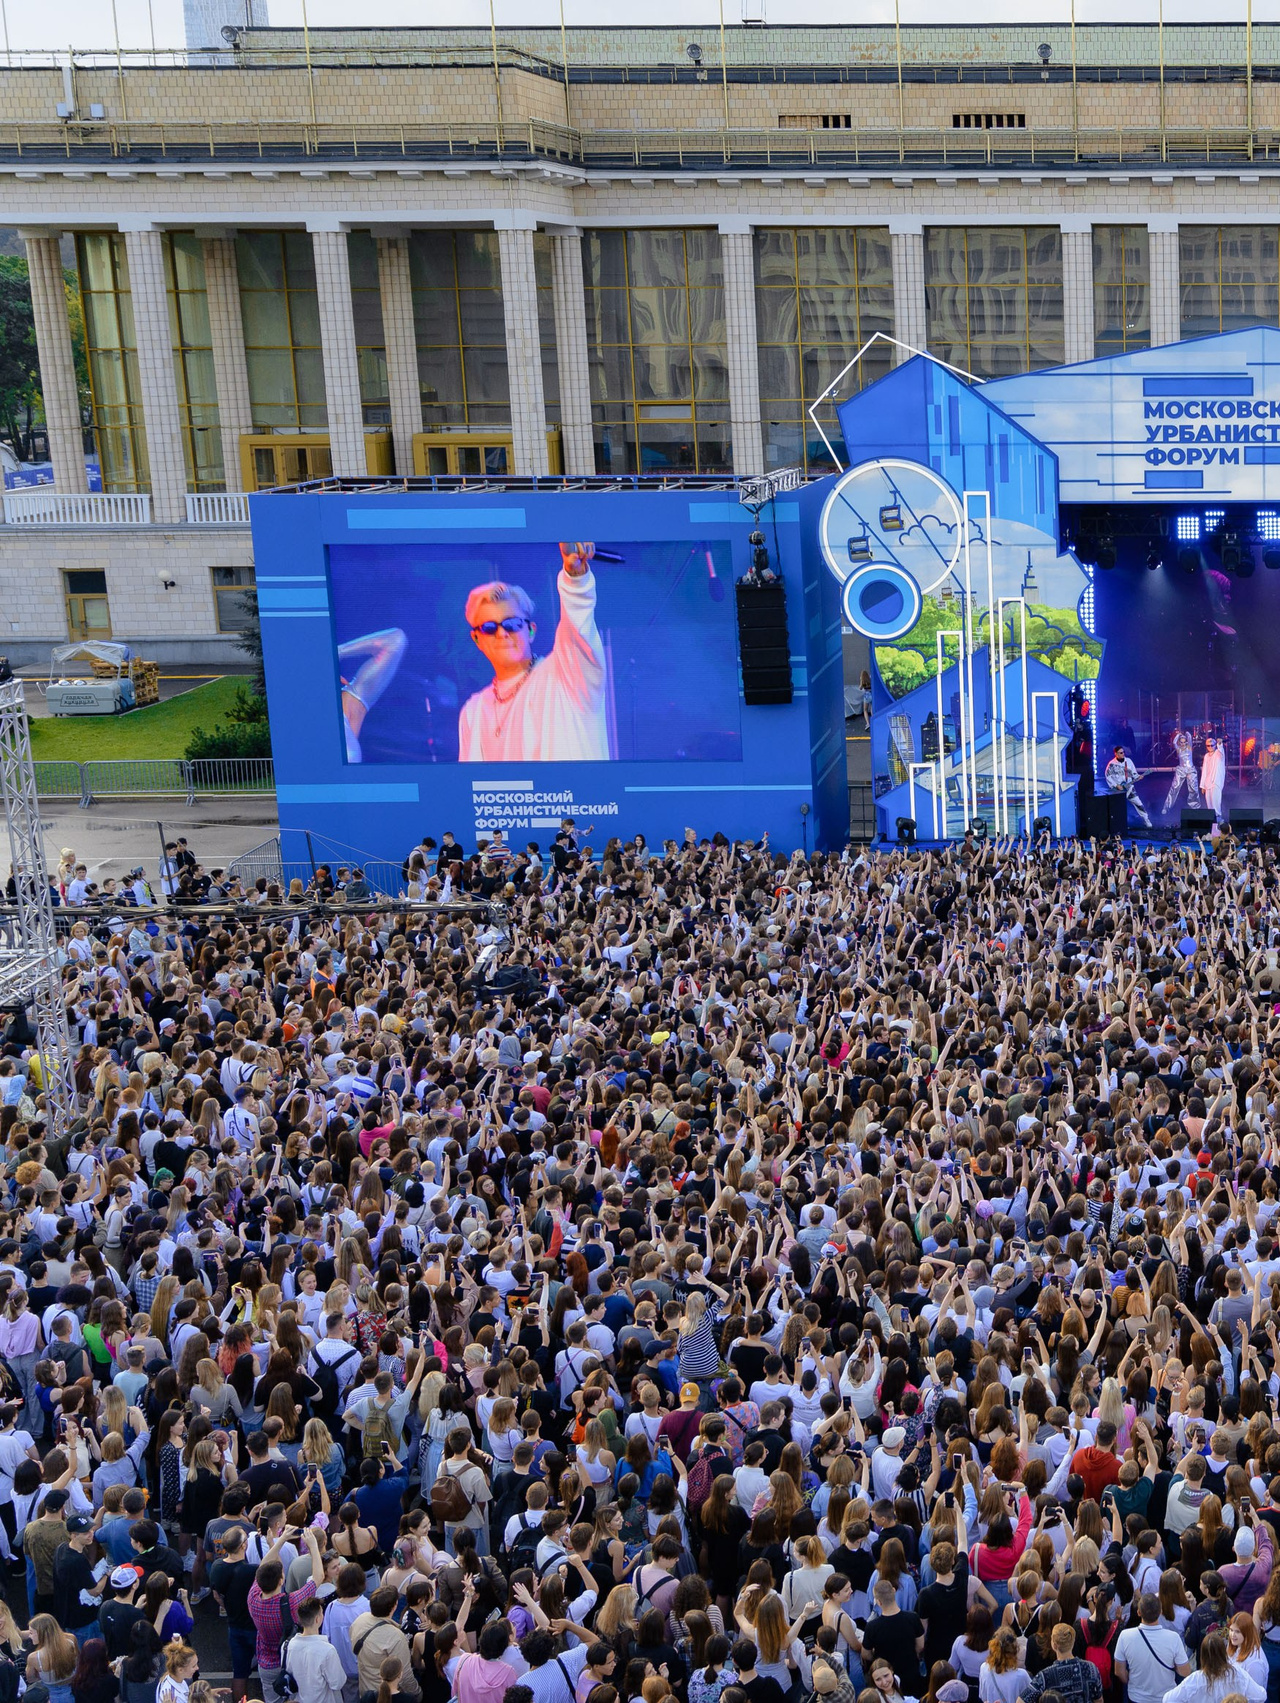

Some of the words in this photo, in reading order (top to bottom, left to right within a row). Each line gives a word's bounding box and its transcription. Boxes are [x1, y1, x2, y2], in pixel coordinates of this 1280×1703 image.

[1144, 447, 1239, 466] ФОРУМ
[473, 790, 573, 803] МОСКОВСКИЙ
[475, 803, 618, 816] УРБАНИСТИЧЕСКИЙ
[475, 818, 528, 829] ФОРУМ
